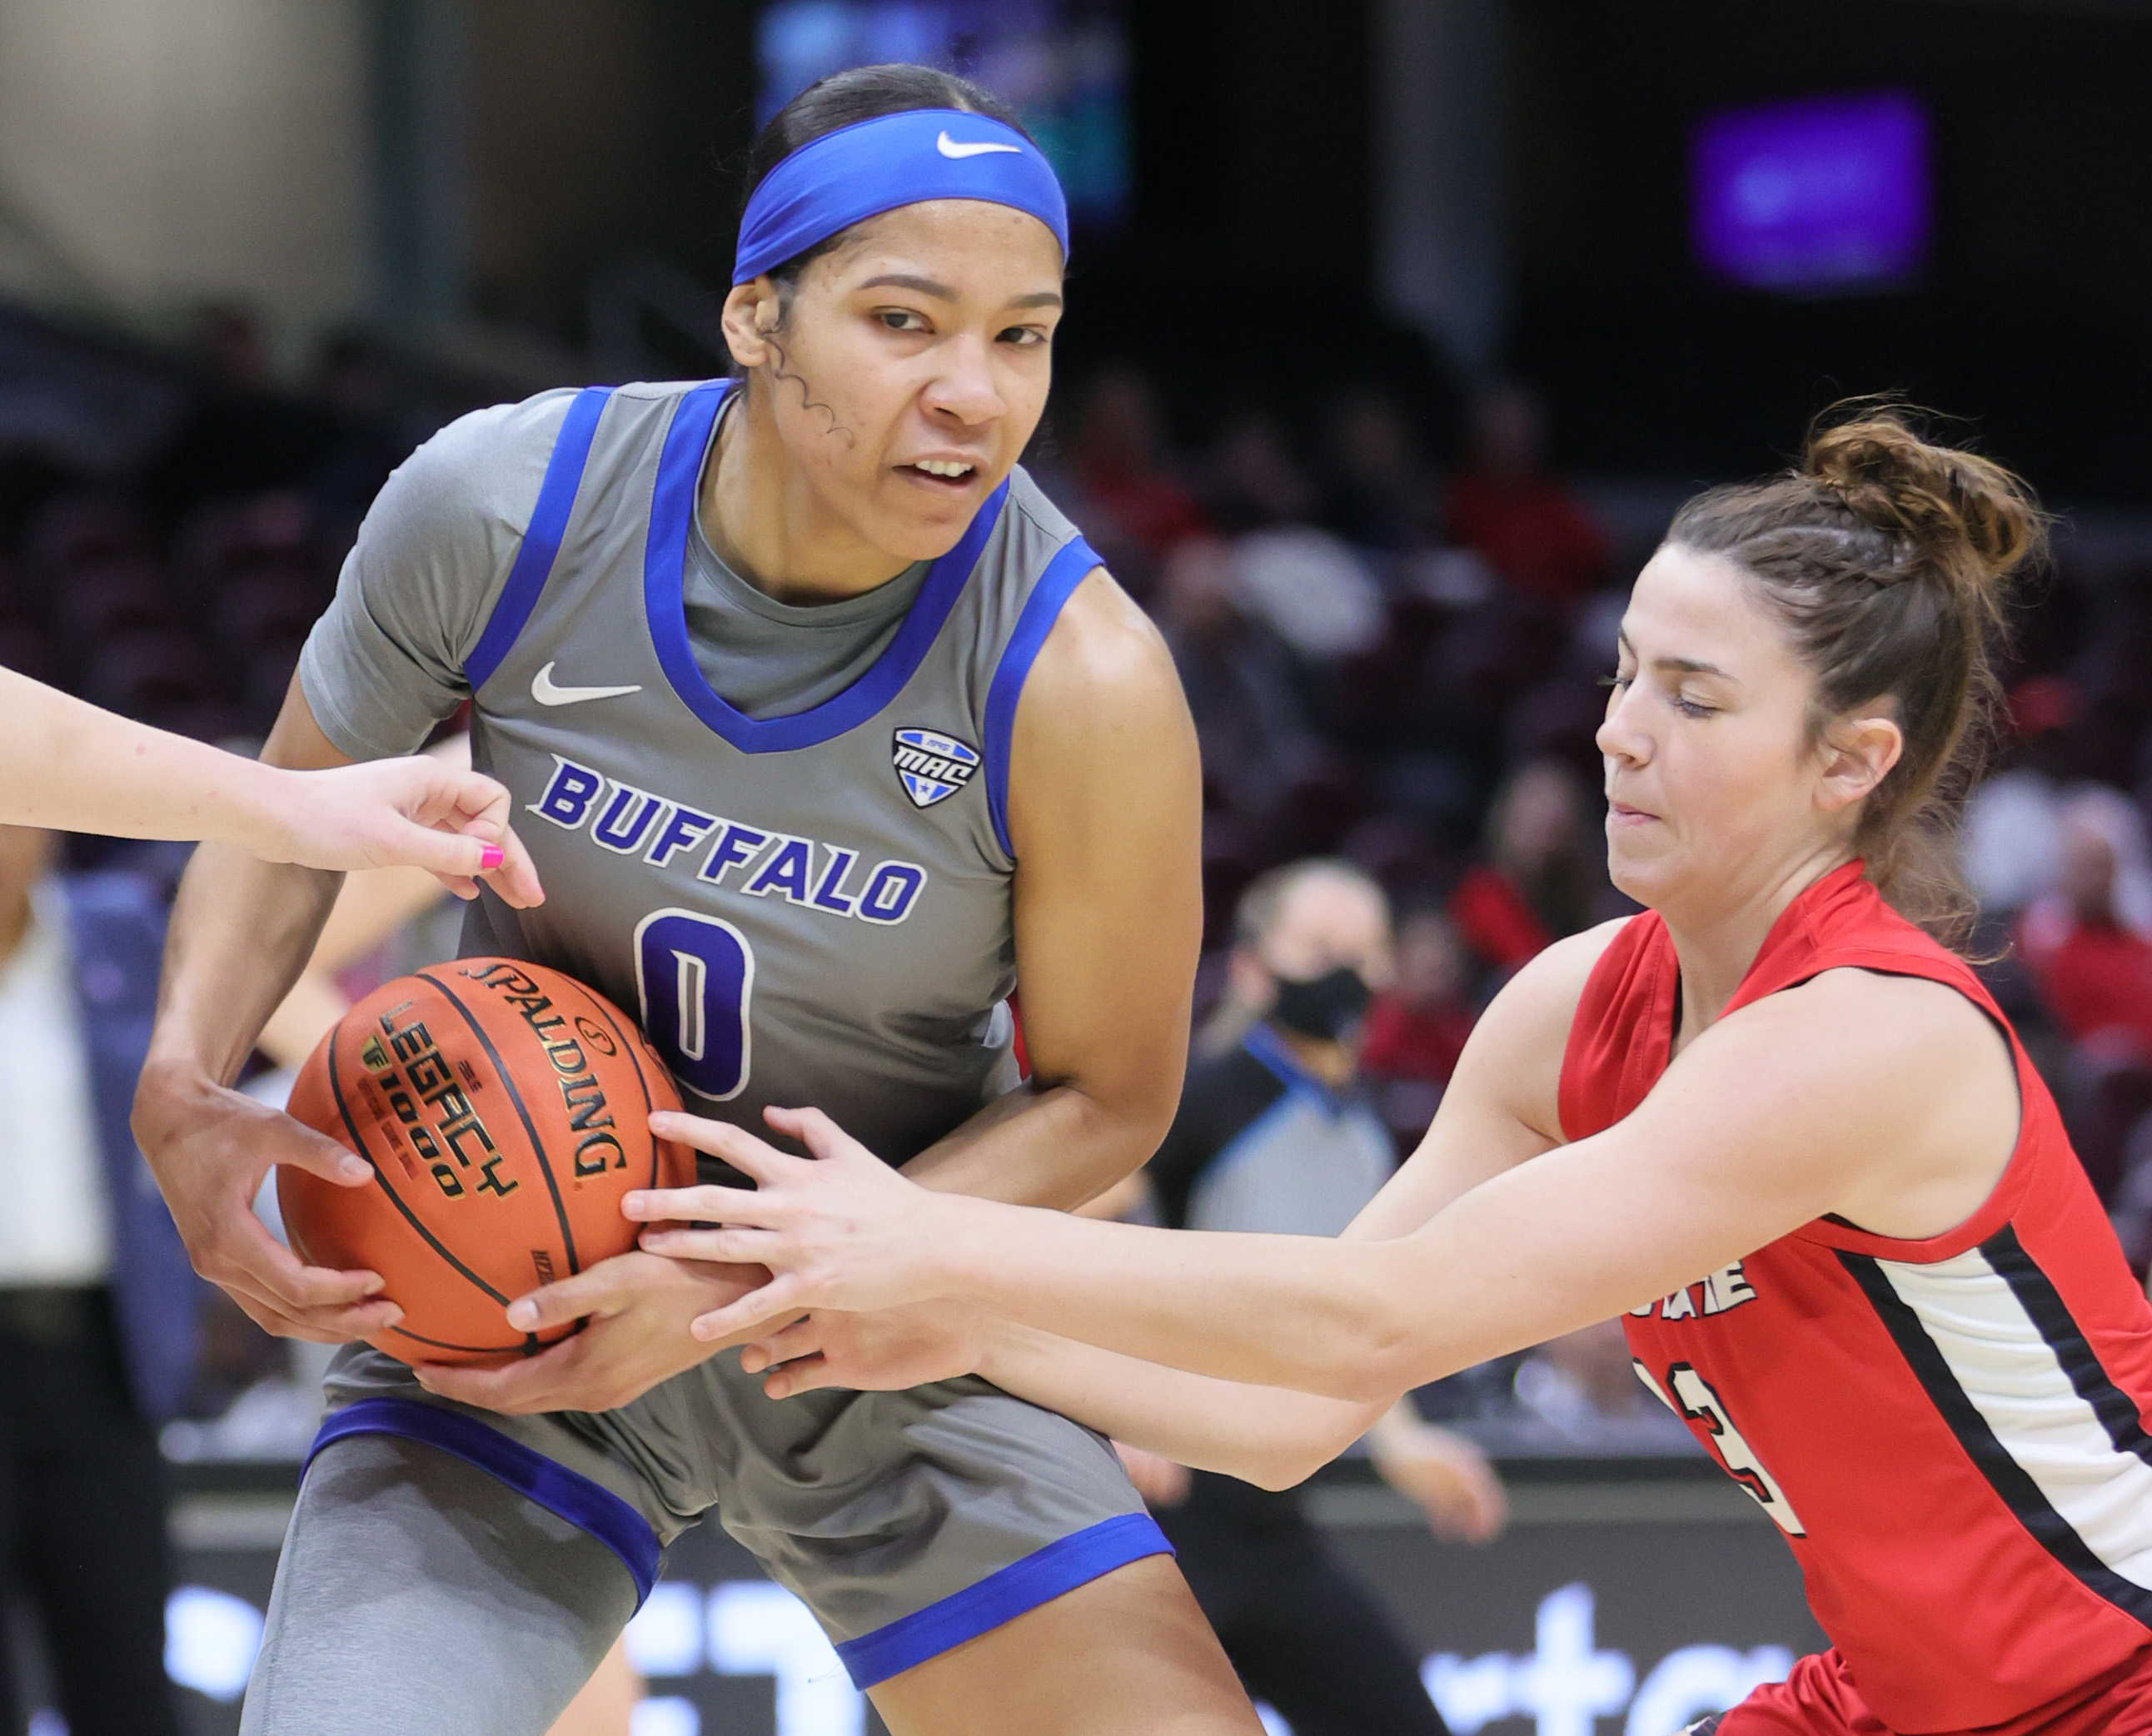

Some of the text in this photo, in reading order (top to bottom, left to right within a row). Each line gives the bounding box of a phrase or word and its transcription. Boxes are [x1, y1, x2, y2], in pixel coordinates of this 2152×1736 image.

[525, 753, 927, 925] BUFFALO
[894, 745, 973, 785] MAC
[457, 963, 626, 1180] SPALDING
[634, 907, 755, 1101] 0
[379, 1072, 466, 1200] 1000
[380, 1000, 520, 1200] LEGACY
